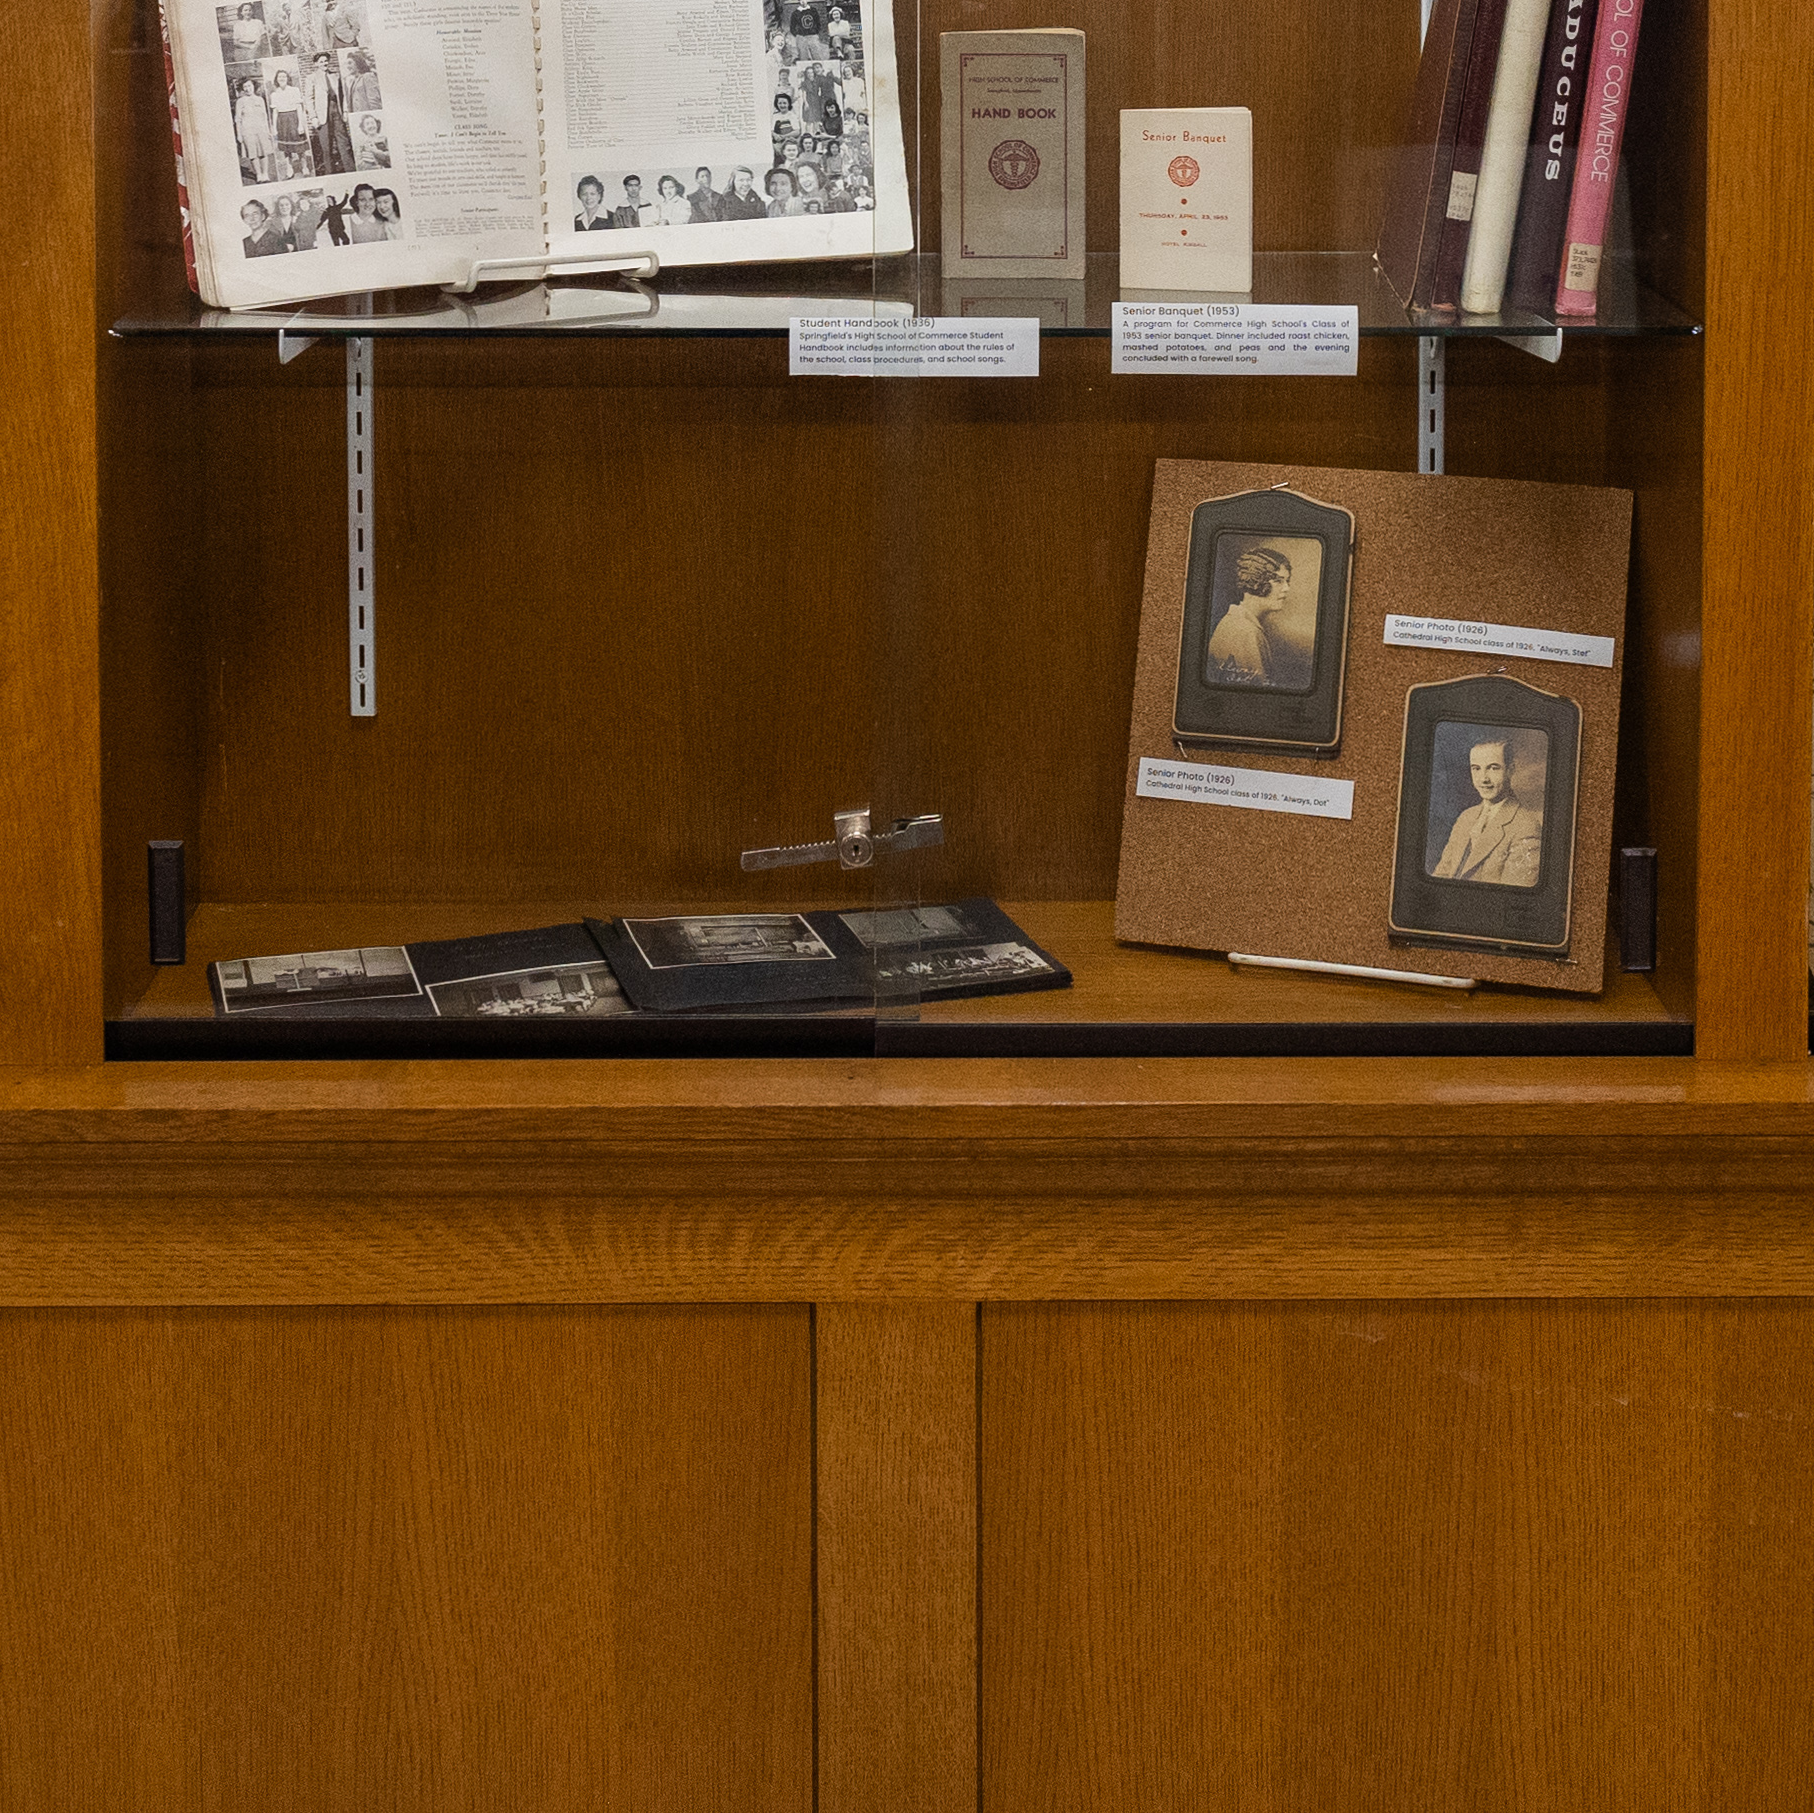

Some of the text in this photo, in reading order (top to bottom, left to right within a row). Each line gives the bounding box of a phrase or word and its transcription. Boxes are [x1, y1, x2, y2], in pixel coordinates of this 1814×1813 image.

[1609, 30, 1629, 59] OF
[972, 107, 1056, 119] HAND BOOK
[1591, 64, 1624, 183] COMMERCE
[1142, 129, 1226, 144] Senior Banquet
[1122, 303, 1243, 318] Senior Banquet (1953)
[800, 315, 938, 329] Student Handbook (1936)
[1147, 767, 1235, 786] Senior Photo (1926)
